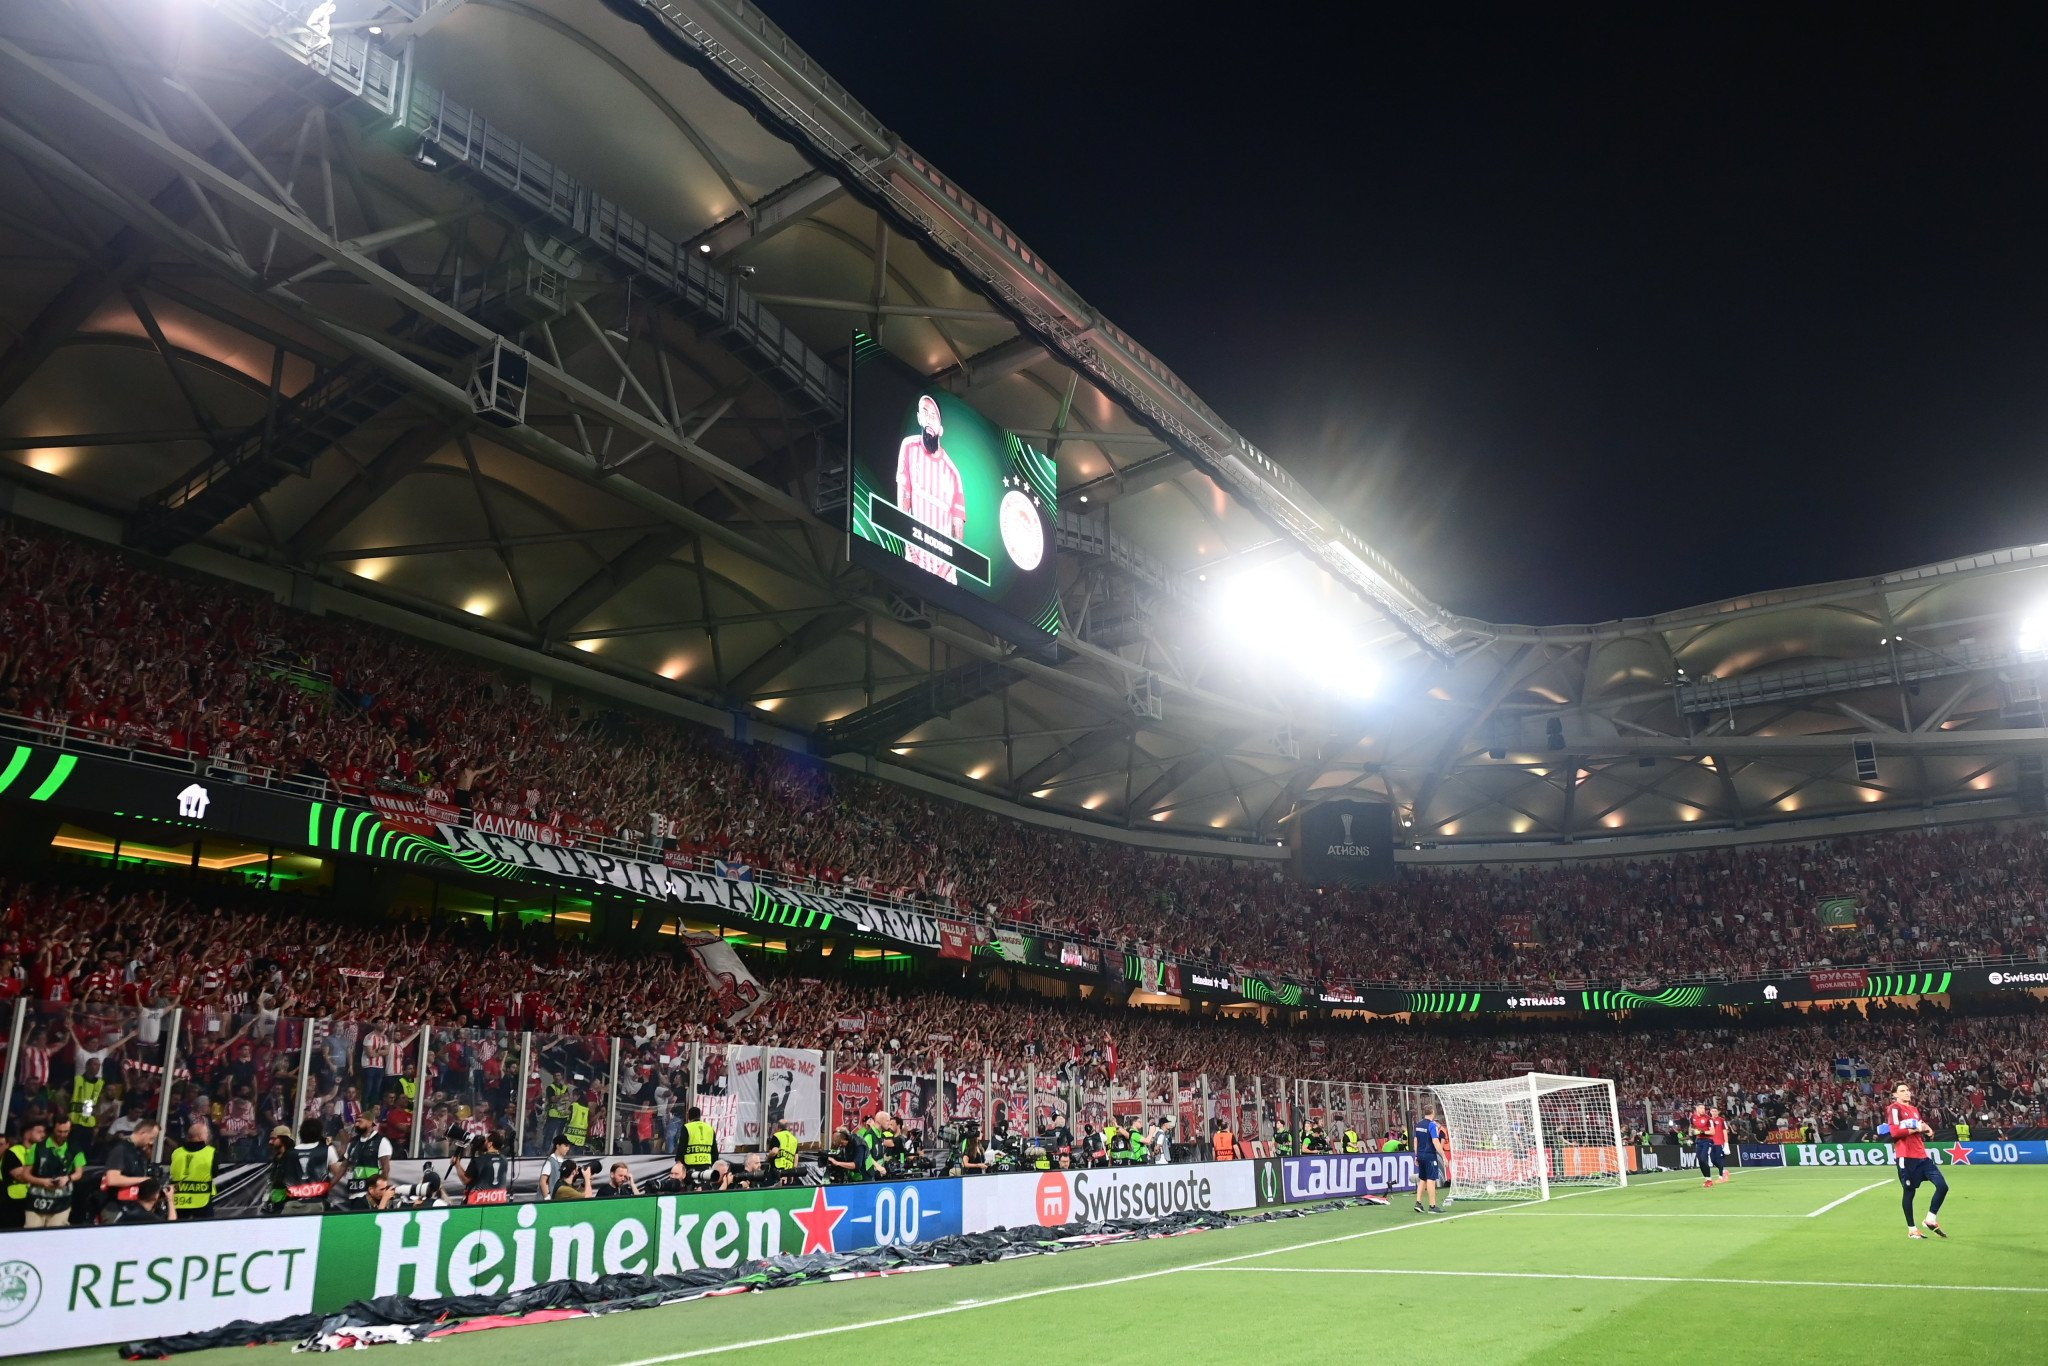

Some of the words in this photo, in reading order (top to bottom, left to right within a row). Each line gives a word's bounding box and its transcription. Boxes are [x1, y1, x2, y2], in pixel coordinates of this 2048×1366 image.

[1327, 845, 1370, 856] ATHENS
[669, 866, 754, 915] ΣΤΑ
[900, 912, 941, 946] ΜΑΣ
[1834, 907, 1843, 918] 2
[1519, 996, 1566, 1007] STRAUSS
[1785, 1131, 1802, 1140] DEA
[1749, 1151, 1781, 1161] RESPECT
[1989, 1142, 2019, 1164] 0.0
[1284, 1155, 1417, 1198] Laufenn
[1073, 1168, 1212, 1223] Swissquote
[373, 1195, 783, 1301] Heineken
[874, 1186, 921, 1248] 0.0
[68, 1248, 306, 1312] RESPECT
